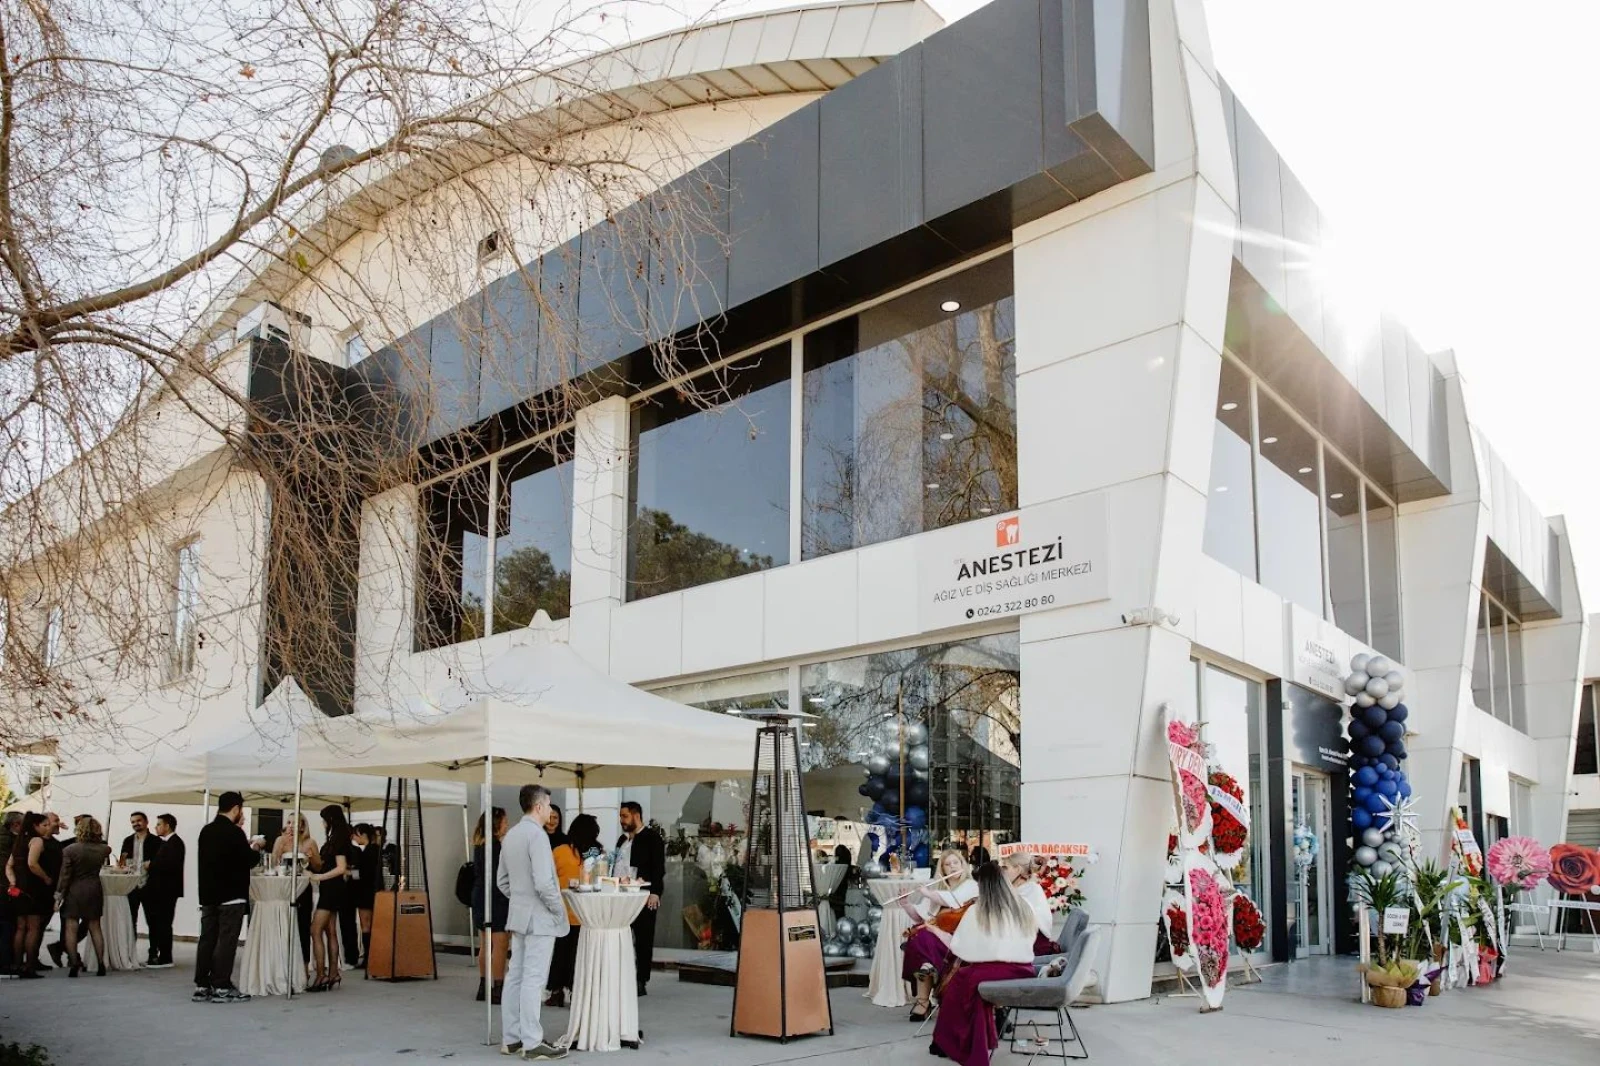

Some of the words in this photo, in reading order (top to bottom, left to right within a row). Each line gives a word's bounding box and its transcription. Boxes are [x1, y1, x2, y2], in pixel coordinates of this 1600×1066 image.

[957, 536, 1063, 581] ANESTEZİ
[933, 588, 957, 602] AĞIZ
[959, 585, 973, 597] VE
[975, 581, 993, 595] DİŞ
[995, 573, 1039, 591] SAĞLIĞI
[1041, 560, 1092, 581] MERKEZİ
[977, 604, 1002, 617] 0242
[1004, 600, 1022, 613] 322
[1025, 597, 1039, 608] 80
[1041, 594, 1055, 605] 80
